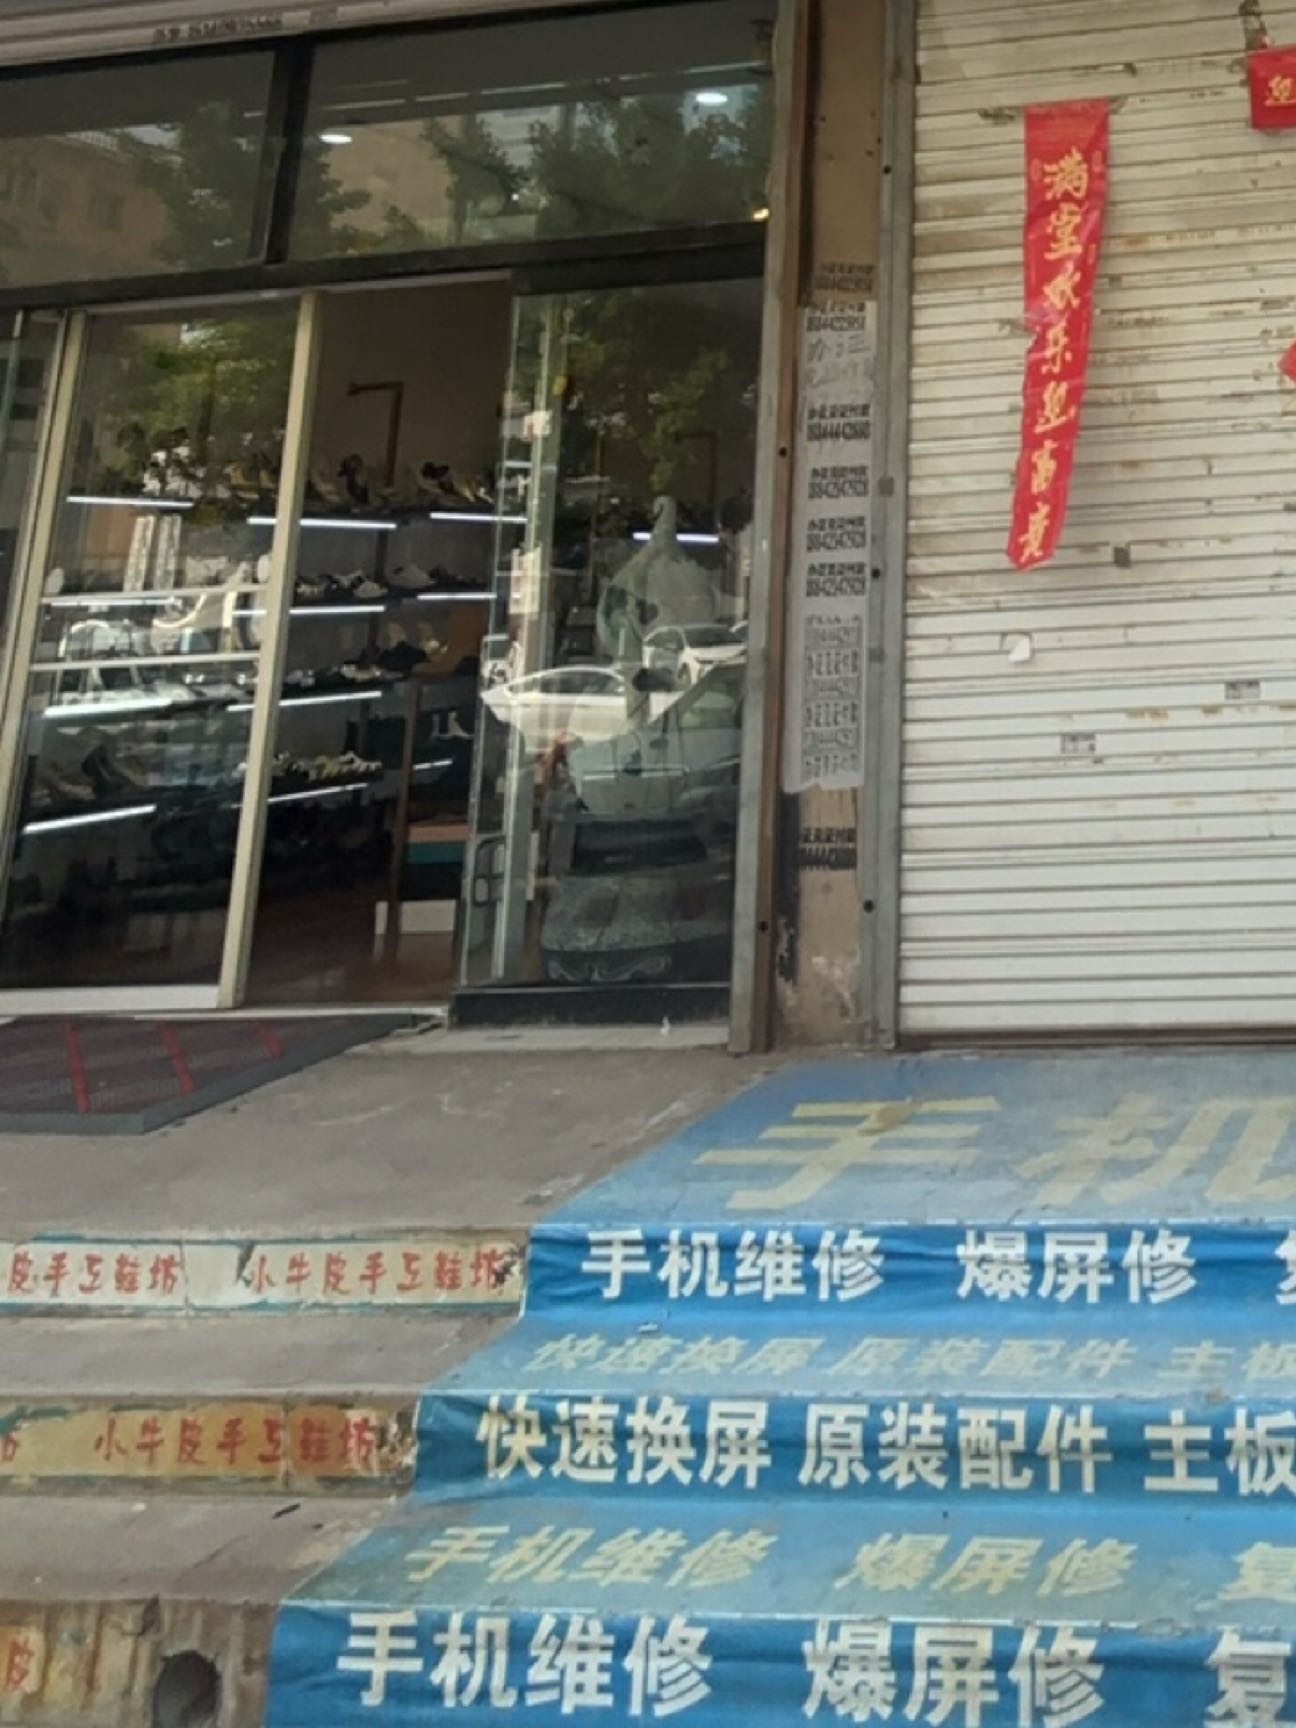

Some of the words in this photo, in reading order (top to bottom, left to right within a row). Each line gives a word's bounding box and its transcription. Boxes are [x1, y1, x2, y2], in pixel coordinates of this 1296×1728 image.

[581, 1228, 884, 1302] 手机维修
[956, 1227, 1197, 1305] 爆屏修
[828, 1336, 1138, 1380] 原装配件
[475, 1394, 772, 1489] 快速换屏
[798, 1400, 1112, 1494] 原装配件
[405, 1524, 778, 1589] 手机维修
[833, 1532, 1139, 1598] 爆屏修
[336, 1610, 713, 1717] 手机维修
[802, 1617, 1105, 1728] 爆屏修
